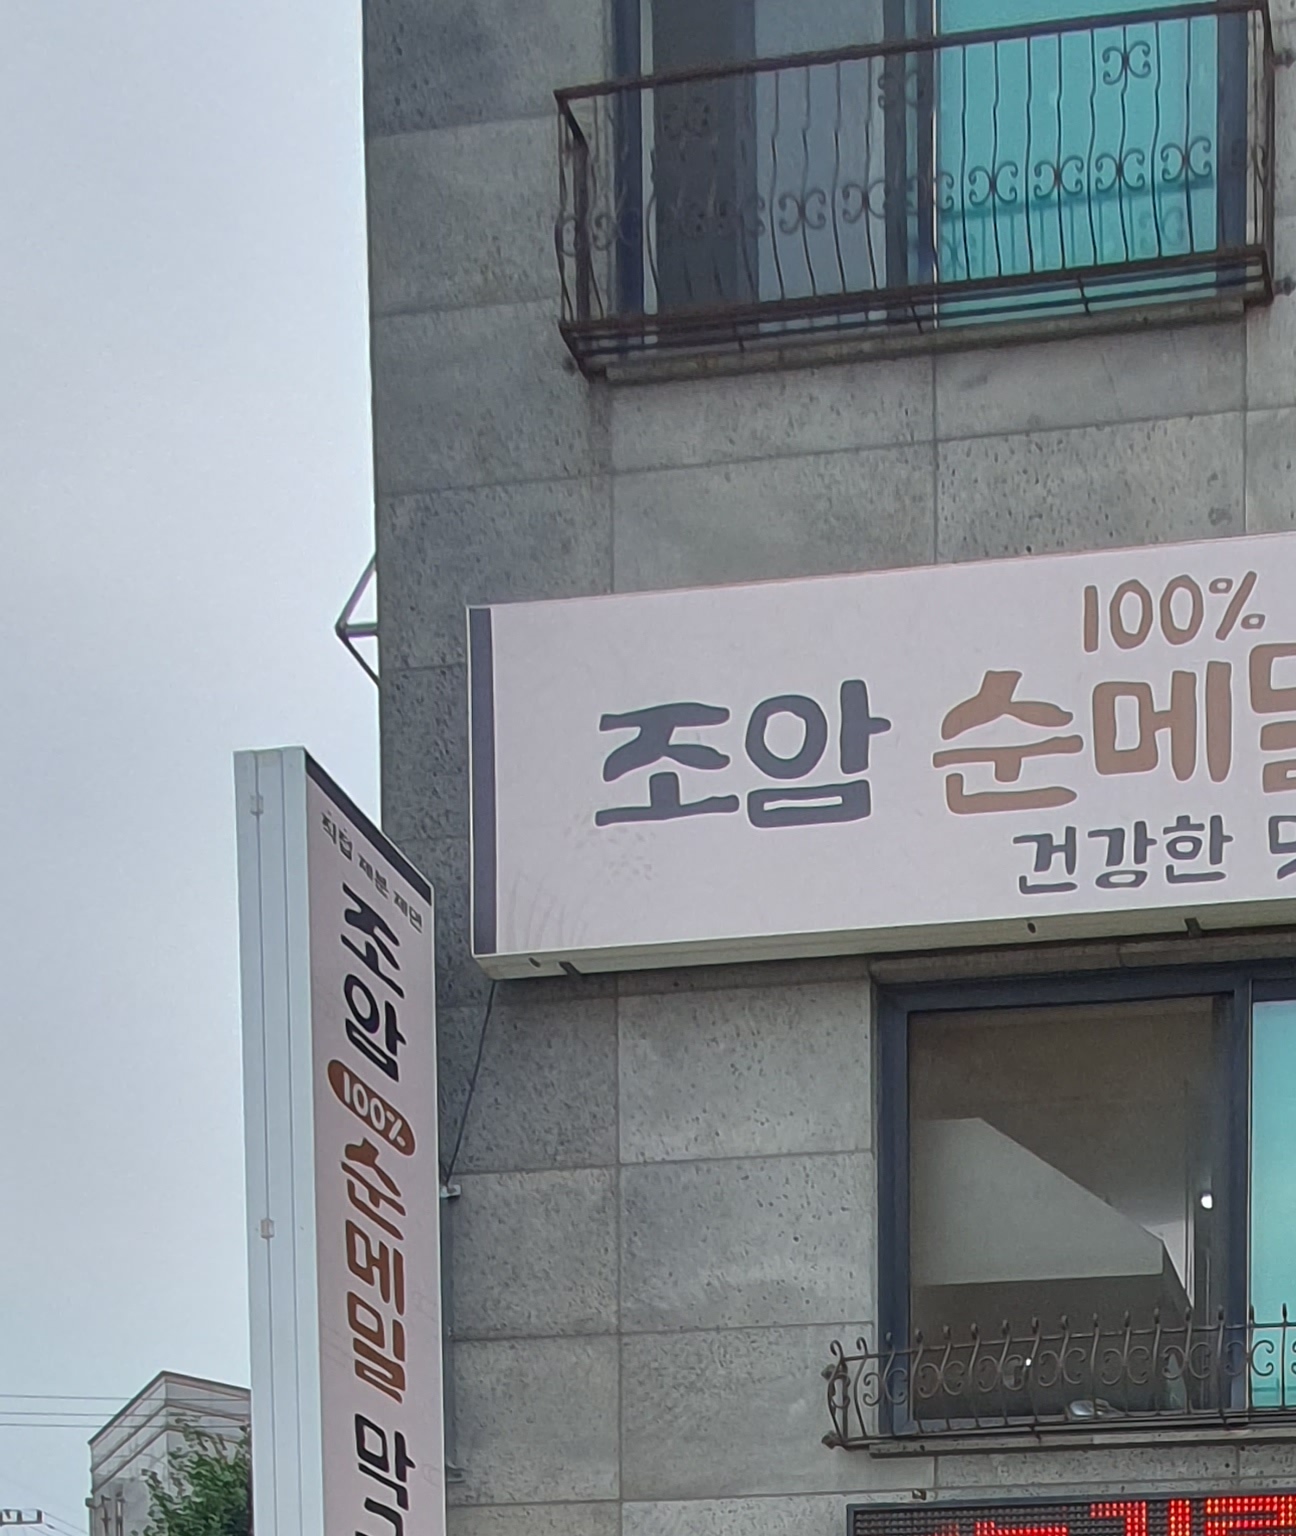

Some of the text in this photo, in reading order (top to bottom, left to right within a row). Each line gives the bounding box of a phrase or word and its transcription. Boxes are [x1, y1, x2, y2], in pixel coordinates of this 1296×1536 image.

[1083, 571, 1265, 652] 100%
[595, 679, 891, 829] 조암
[1013, 815, 1233, 894] 건강한
[341, 882, 406, 1083] 조암
[343, 1071, 406, 1147] 100%
[341, 1137, 407, 1405] 순메밀
